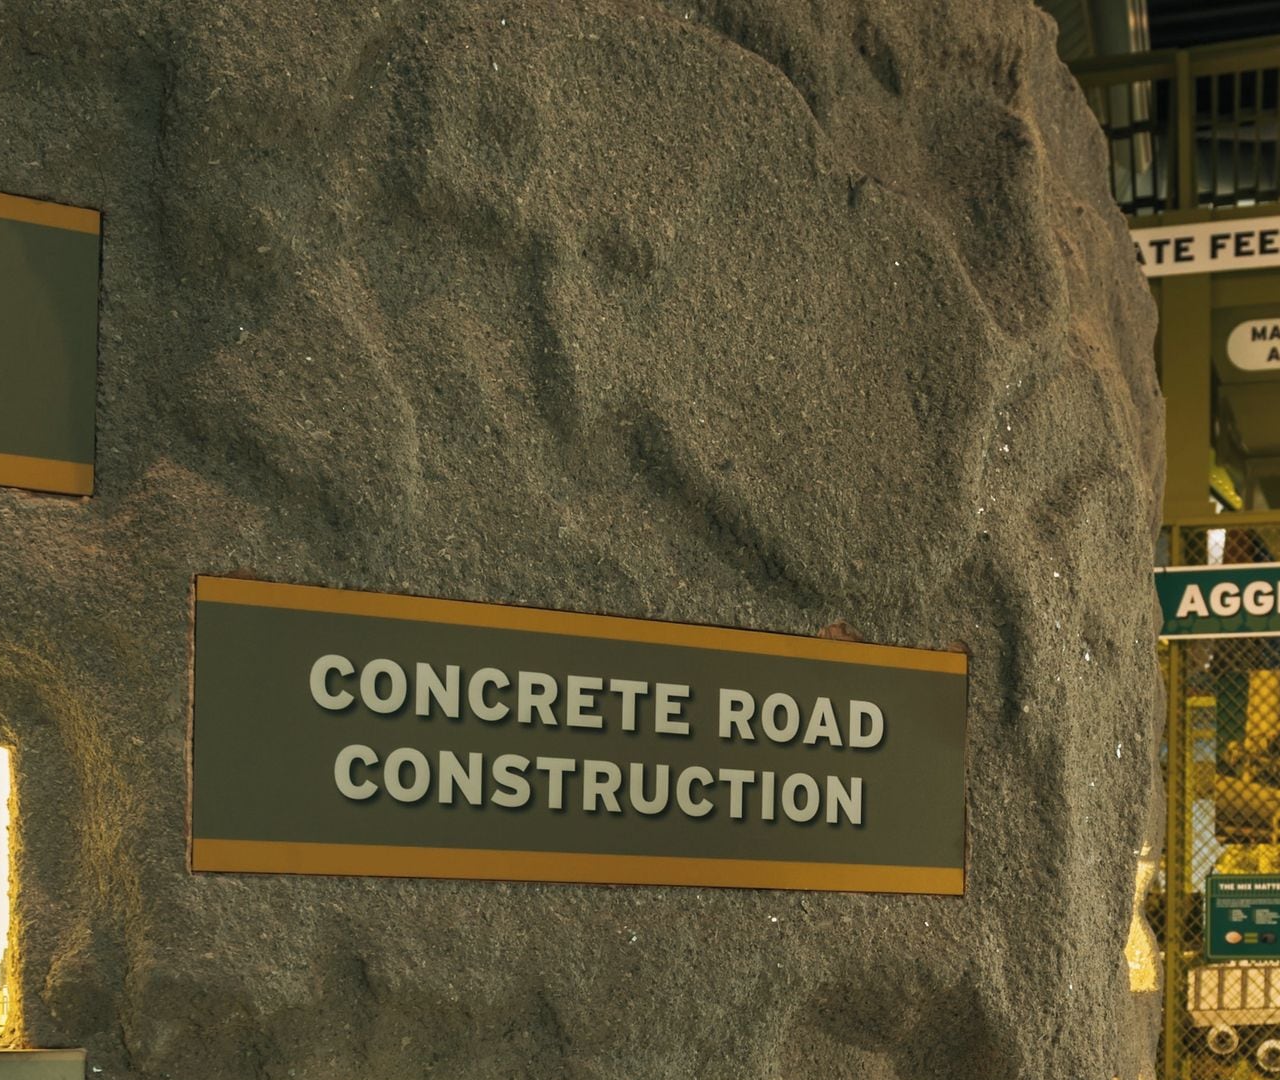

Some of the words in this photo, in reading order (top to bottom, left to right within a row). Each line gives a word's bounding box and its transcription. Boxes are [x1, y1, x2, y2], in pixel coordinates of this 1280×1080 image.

[308, 653, 691, 736] CONCRETE
[718, 687, 885, 750] ROAD
[333, 744, 864, 826] CONSTRUCTION
[1219, 882, 1235, 891] THE
[1237, 882, 1252, 891] MIX
